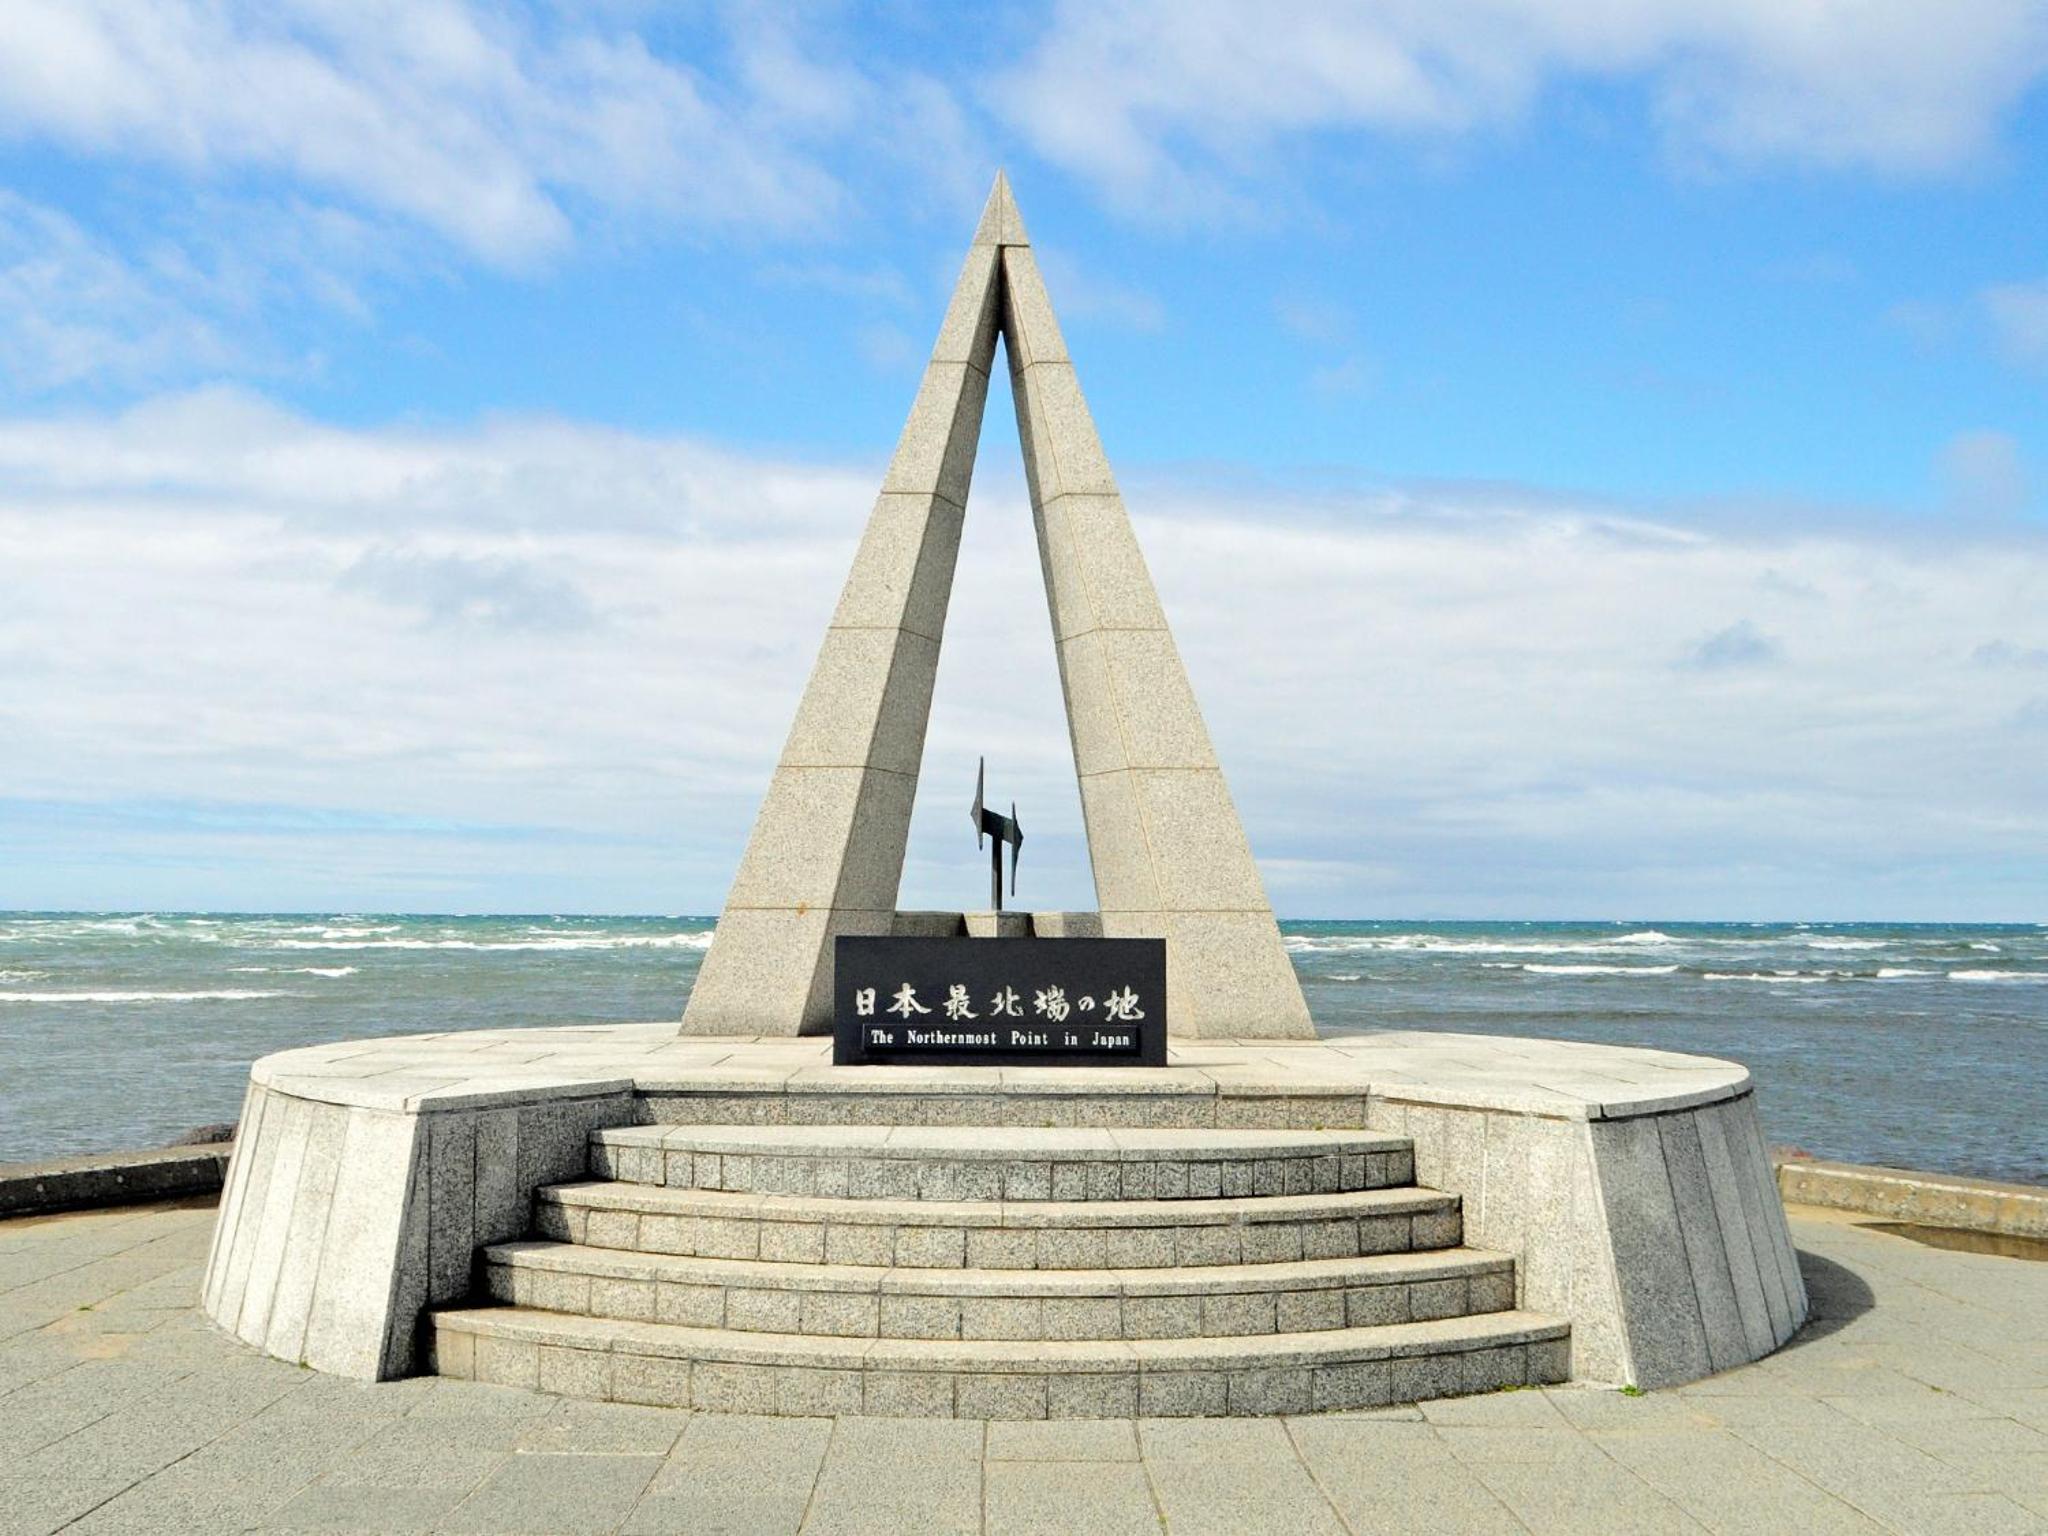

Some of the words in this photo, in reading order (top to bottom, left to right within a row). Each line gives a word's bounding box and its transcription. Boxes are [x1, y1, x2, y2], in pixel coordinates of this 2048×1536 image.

[855, 982, 1146, 1022] 日本最北端の地
[870, 1029, 894, 1045] The
[907, 1029, 998, 1045] Northernmost
[1010, 1030, 1049, 1046] Point
[1064, 1030, 1078, 1046] in
[1092, 1030, 1130, 1048] Japan
